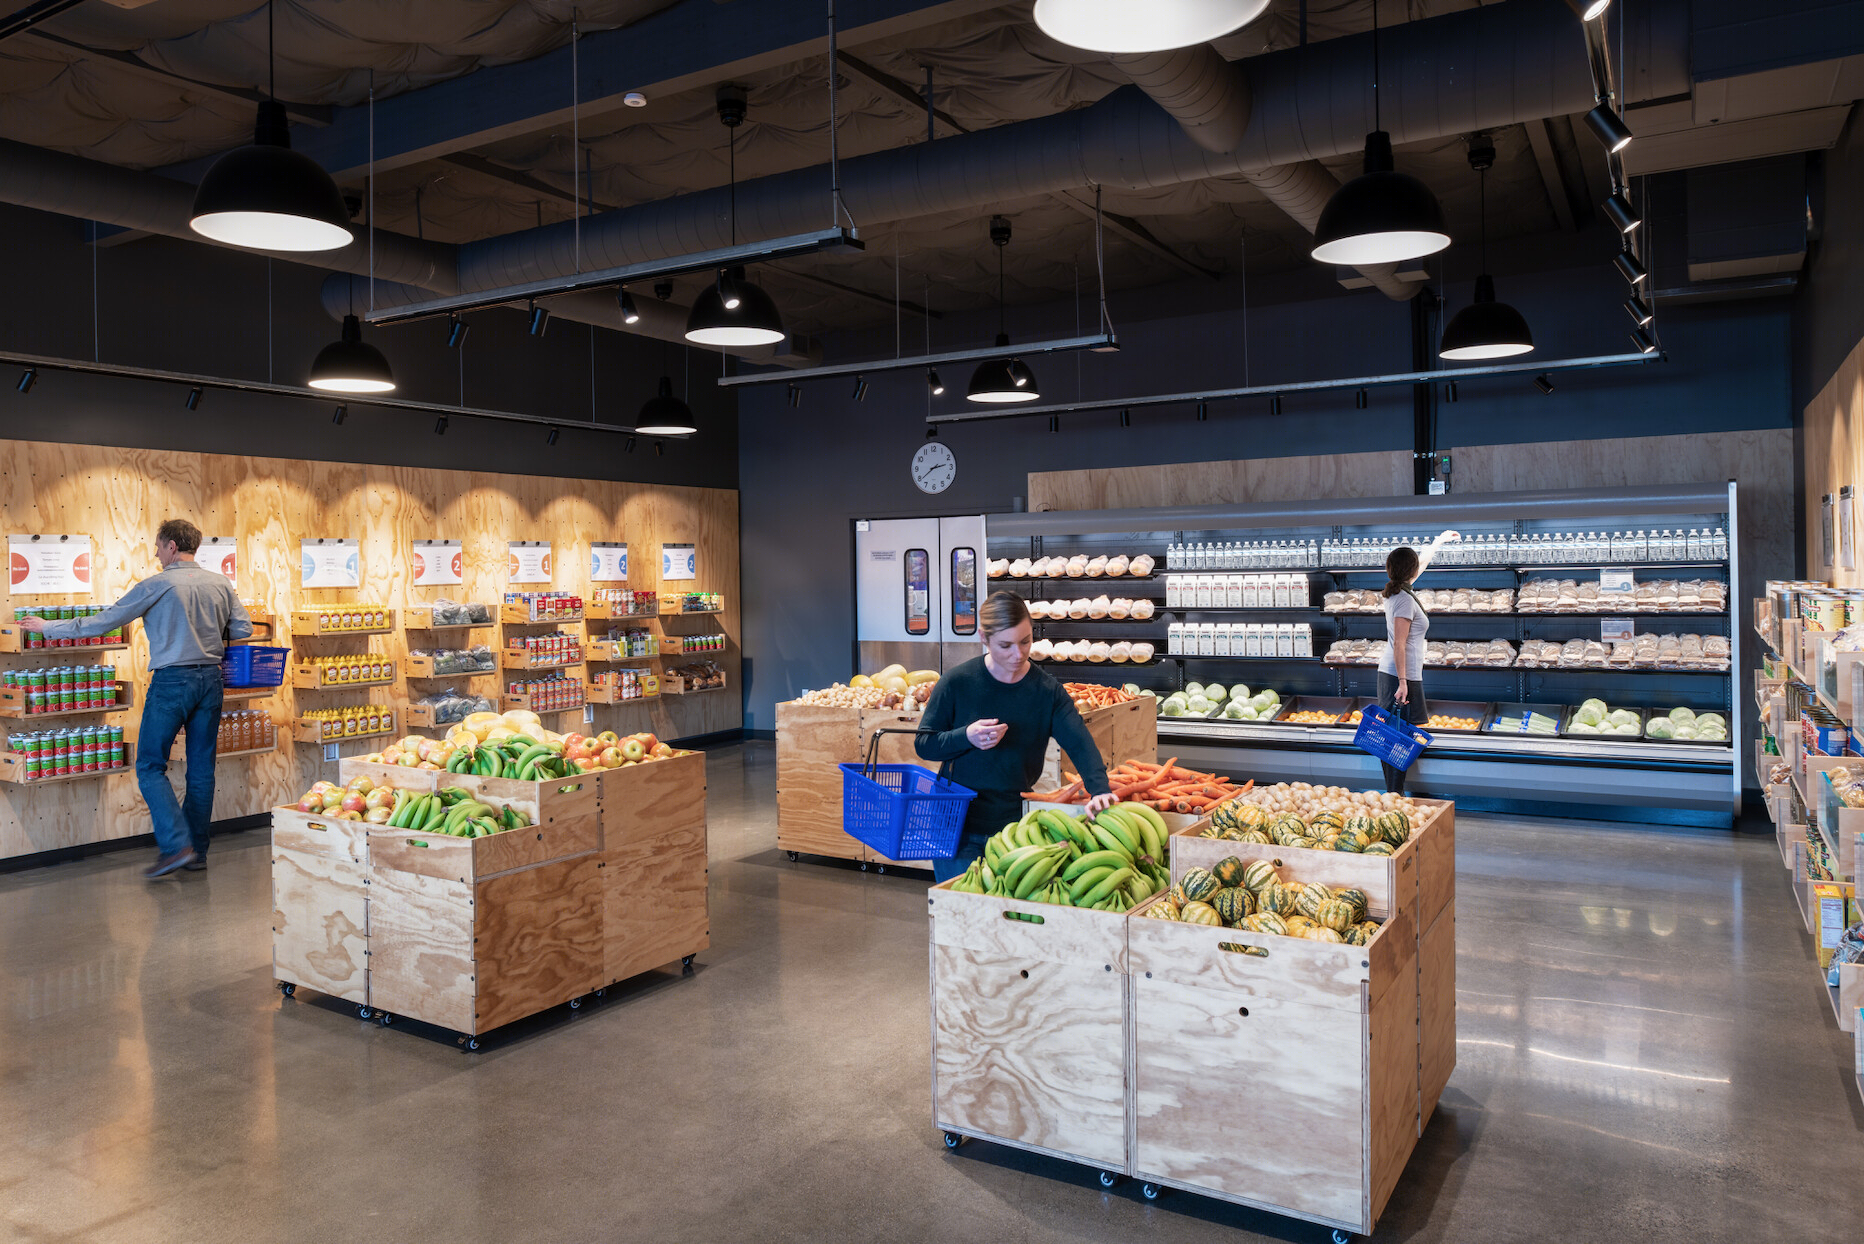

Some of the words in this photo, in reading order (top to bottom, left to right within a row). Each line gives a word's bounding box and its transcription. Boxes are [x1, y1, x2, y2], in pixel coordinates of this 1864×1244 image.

[225, 562, 233, 575] 1
[349, 561, 355, 571] 1
[453, 560, 460, 571] 2
[543, 560, 549, 570] 1
[620, 560, 626, 570] 2
[688, 560, 694, 569] 2
